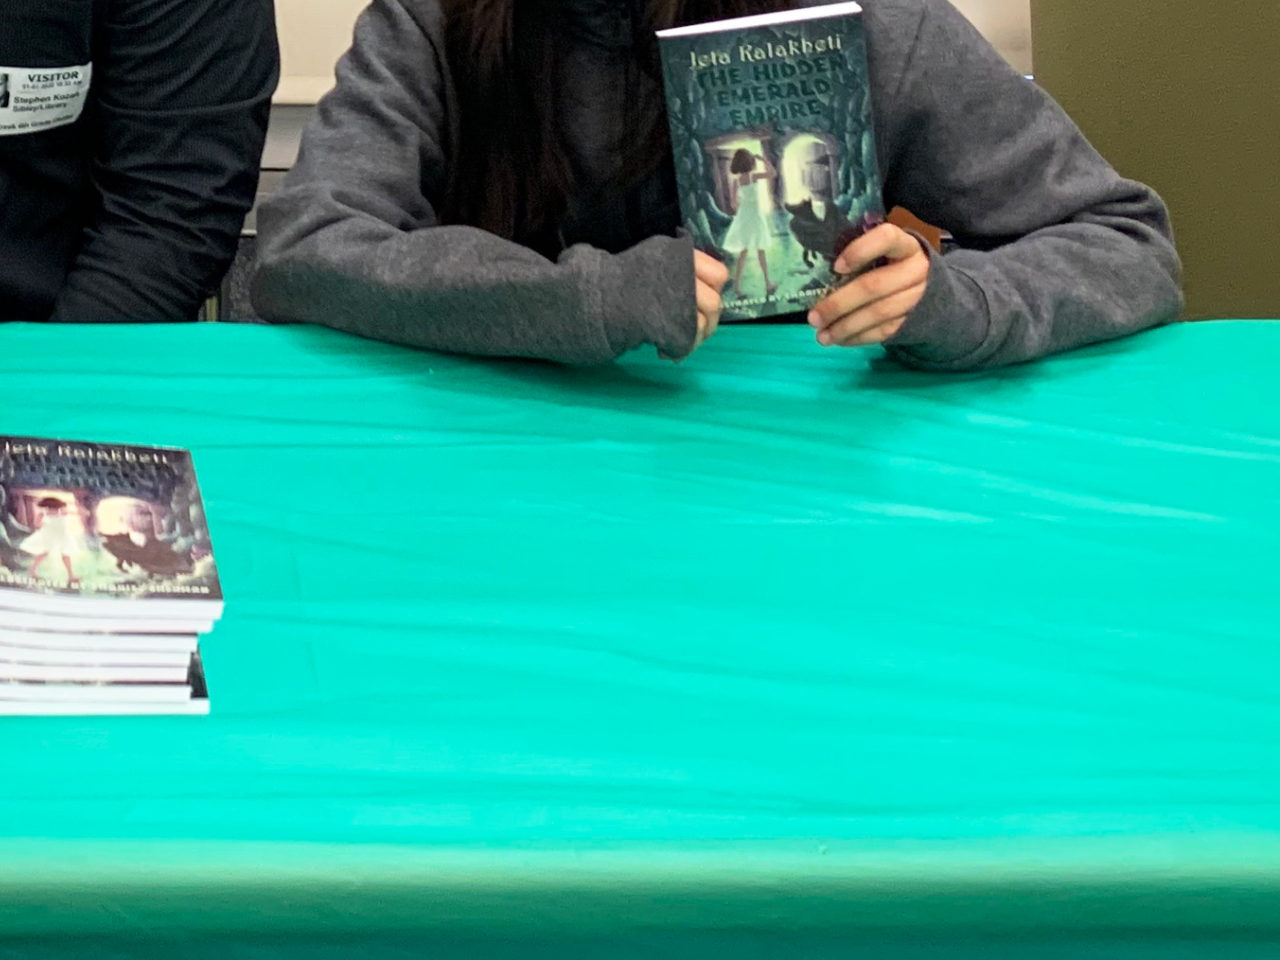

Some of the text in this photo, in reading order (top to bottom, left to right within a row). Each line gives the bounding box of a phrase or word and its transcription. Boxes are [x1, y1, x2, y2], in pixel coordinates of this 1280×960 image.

[689, 34, 842, 69] Jeta Kalakheti
[28, 71, 79, 82] VISITOR
[696, 53, 848, 89] THE HIDDEN
[14, 96, 51, 104] Stephen
[718, 78, 831, 106] EMERALD
[729, 100, 821, 127] EMPIRE
